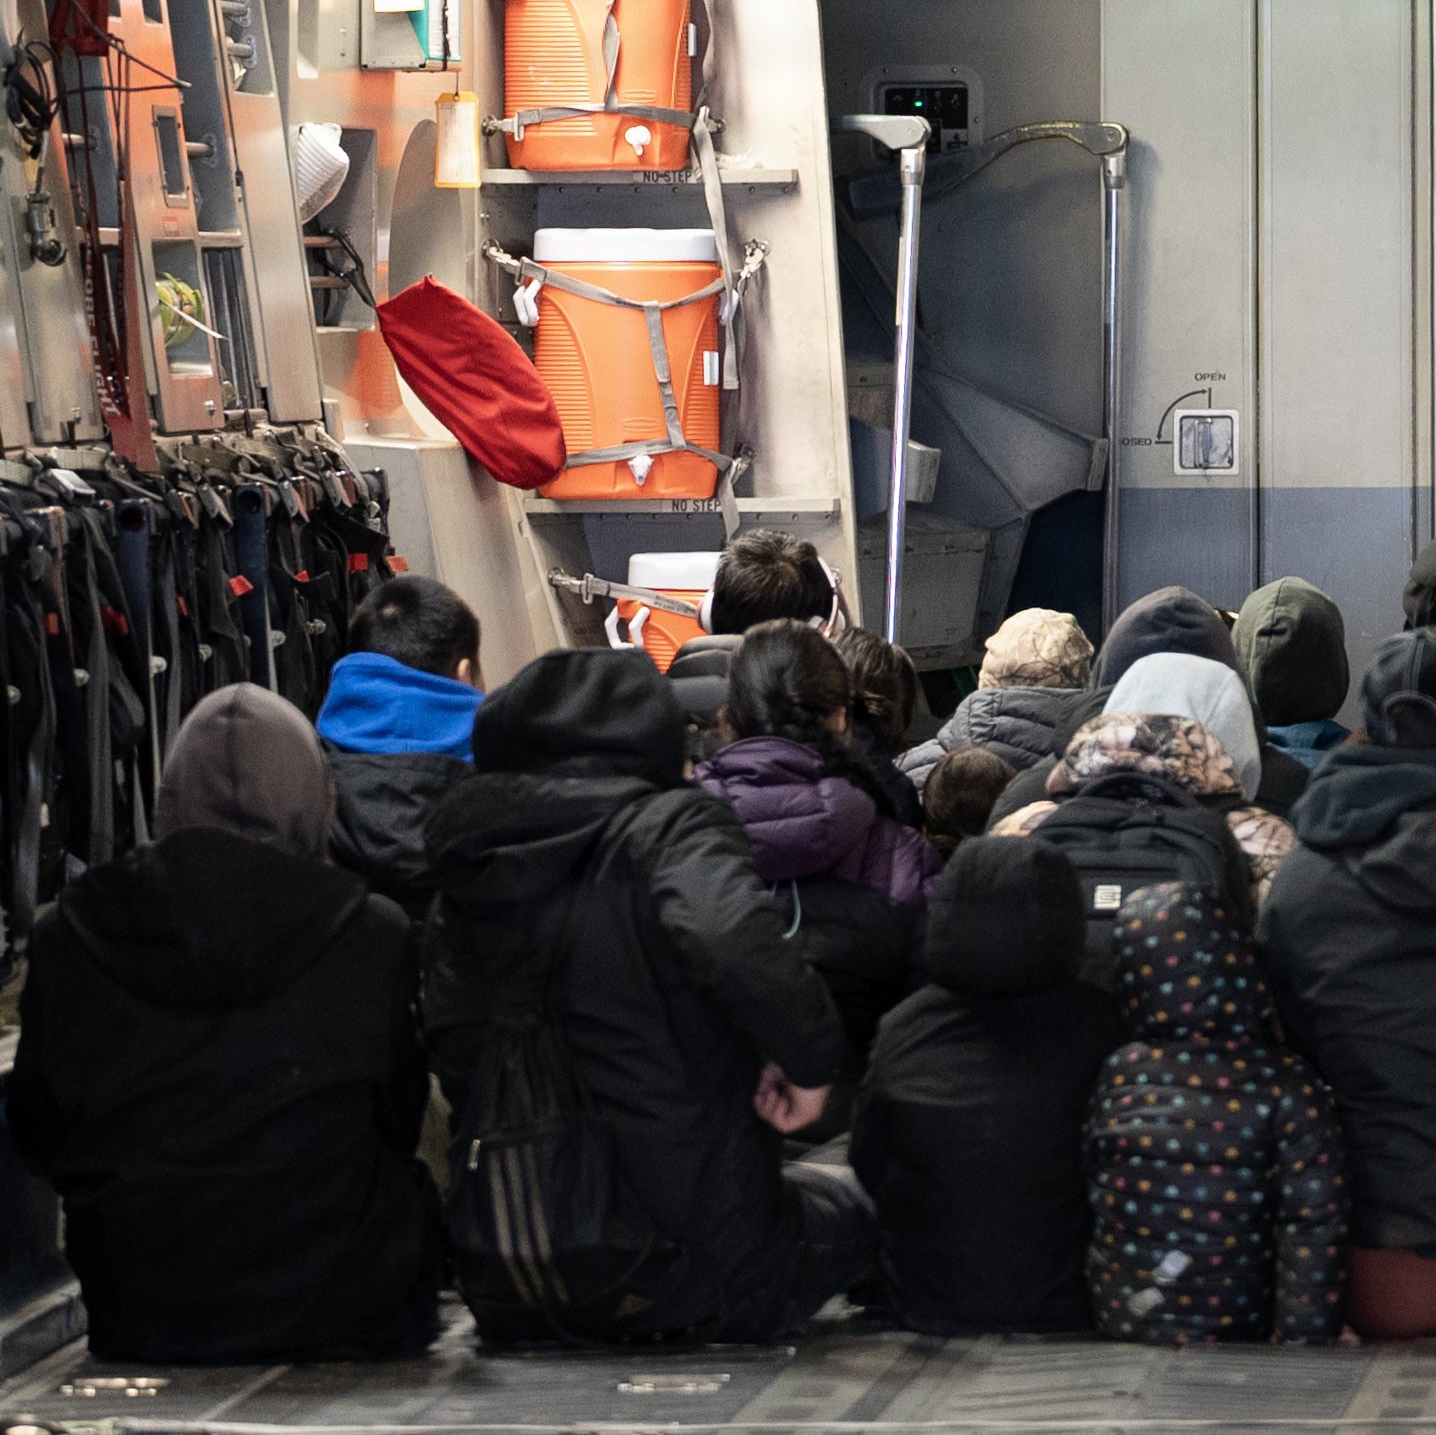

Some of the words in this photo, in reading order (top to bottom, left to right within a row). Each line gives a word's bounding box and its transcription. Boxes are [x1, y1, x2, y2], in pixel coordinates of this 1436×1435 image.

[643, 170, 660, 183] NO
[663, 170, 692, 183] STEP
[1194, 372, 1226, 381] OPEN
[1120, 437, 1153, 446] OSED
[672, 499, 687, 512] NO
[693, 499, 721, 512] STEP
